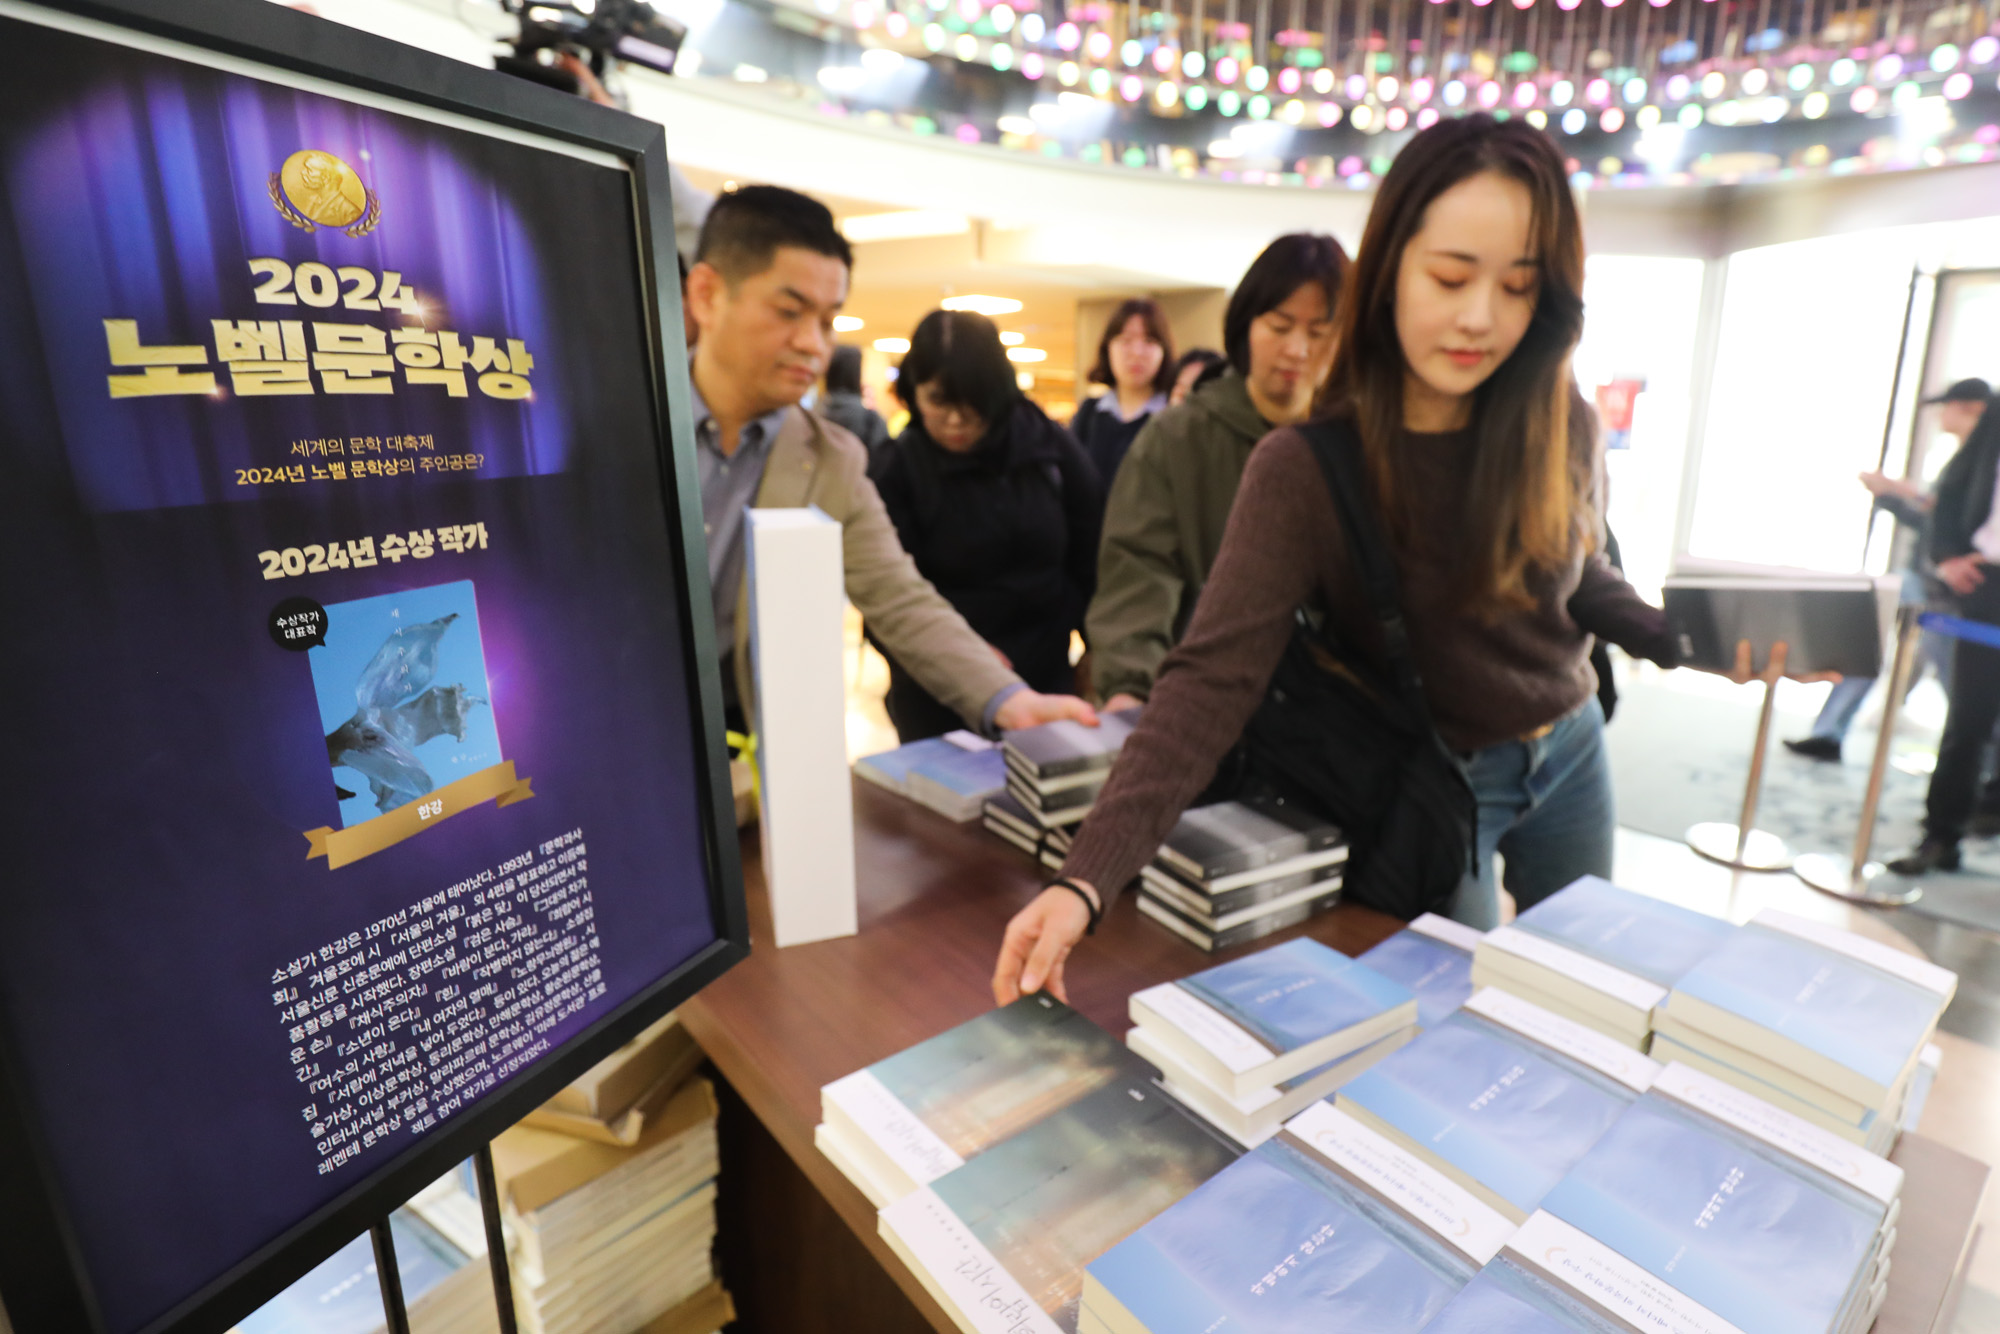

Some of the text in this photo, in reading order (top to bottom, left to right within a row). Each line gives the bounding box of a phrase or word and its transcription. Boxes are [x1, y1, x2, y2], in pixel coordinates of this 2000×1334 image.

[249, 257, 421, 315] 2024
[103, 319, 534, 400] 노벨문학상
[235, 453, 484, 487] 2024년 노벨 문학상의 주인공은?
[291, 433, 435, 459] 세계의 문학 대축제
[258, 521, 489, 581] 2024년 수상 작가
[276, 611, 320, 629] 수상작가
[284, 624, 317, 640] 대표작
[417, 798, 443, 821] 한강
[272, 952, 316, 984] 소설가
[319, 932, 361, 961] 한강은
[365, 909, 407, 940] 1970년
[410, 891, 446, 917] 겨울에
[447, 869, 496, 898] 태어났다.
[498, 851, 532, 876] 1993년
[281, 986, 338, 1023] 서울신문
[343, 950, 407, 993] 신춘문예에
[409, 925, 456, 959] 단편소설
[529, 865, 576, 898] 당선되면서
[309, 951, 365, 988] 겨울호에
[368, 943, 380, 958] 시
[474, 892, 485, 906] 외
[487, 878, 515, 899] 4편을
[517, 859, 557, 886] 발표하고
[289, 1004, 347, 1043] 품활동을
[351, 974, 406, 1009] 시작했다.
[408, 946, 456, 980] 장편소설
[291, 1047, 305, 1064] 운
[484, 939, 509, 959] 분다,
[583, 891, 592, 903] 시
[433, 997, 467, 1023] 여자의
[586, 923, 595, 934] 시
[303, 1104, 317, 1121] 집
[379, 1046, 417, 1075] 저녁을
[494, 988, 515, 1008] 등이
[517, 970, 540, 995] 있다.
[311, 1104, 357, 1138] 술가상,
[359, 1062, 426, 1105] 이상문학상,
[429, 1024, 488, 1066] 동리문학상,
[489, 990, 544, 1029] 만해문학상,
[317, 1104, 384, 1155] 인터내셔널
[388, 1080, 428, 1109] 부커상,
[430, 1041, 486, 1085] 말라파르테
[489, 1021, 524, 1048] 문학상,
[318, 1140, 360, 1174] 레멘테
[363, 1114, 400, 1147] 문학상
[404, 1098, 428, 1120] 등을
[432, 1059, 490, 1101] 수상했으며,
[438, 1095, 461, 1118] 참여
[463, 1073, 496, 1099] 작가로
